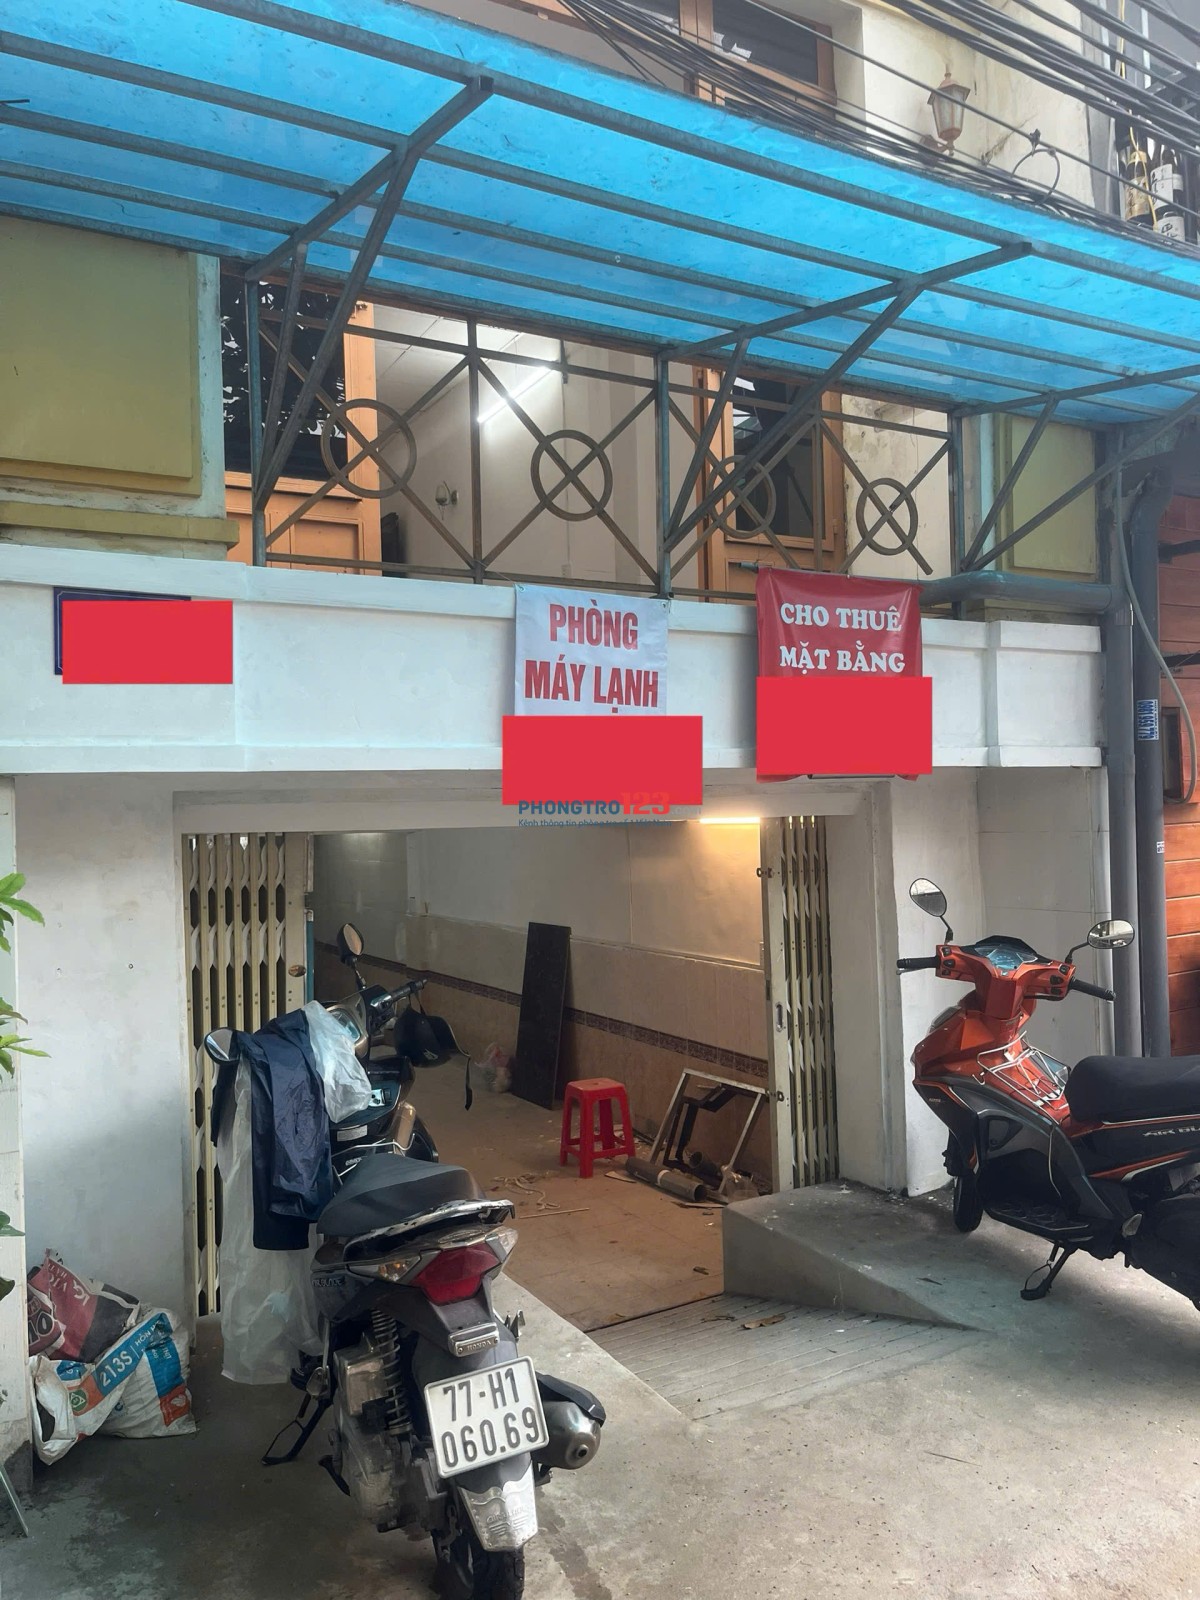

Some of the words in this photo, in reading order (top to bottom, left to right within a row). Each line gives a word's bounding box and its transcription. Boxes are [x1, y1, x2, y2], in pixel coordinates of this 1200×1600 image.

[549, 599, 638, 651] PHÒNG
[780, 602, 830, 627] CHO
[835, 605, 902, 632] THUÊ
[780, 641, 830, 675] MẶT
[836, 640, 905, 673] BẰNG
[525, 654, 586, 702] MÁY
[593, 666, 659, 714] LẠNH
[100, 1350, 133, 1387] 213S
[442, 1367, 520, 1422] 77-H1
[441, 1406, 540, 1468] 060.69
